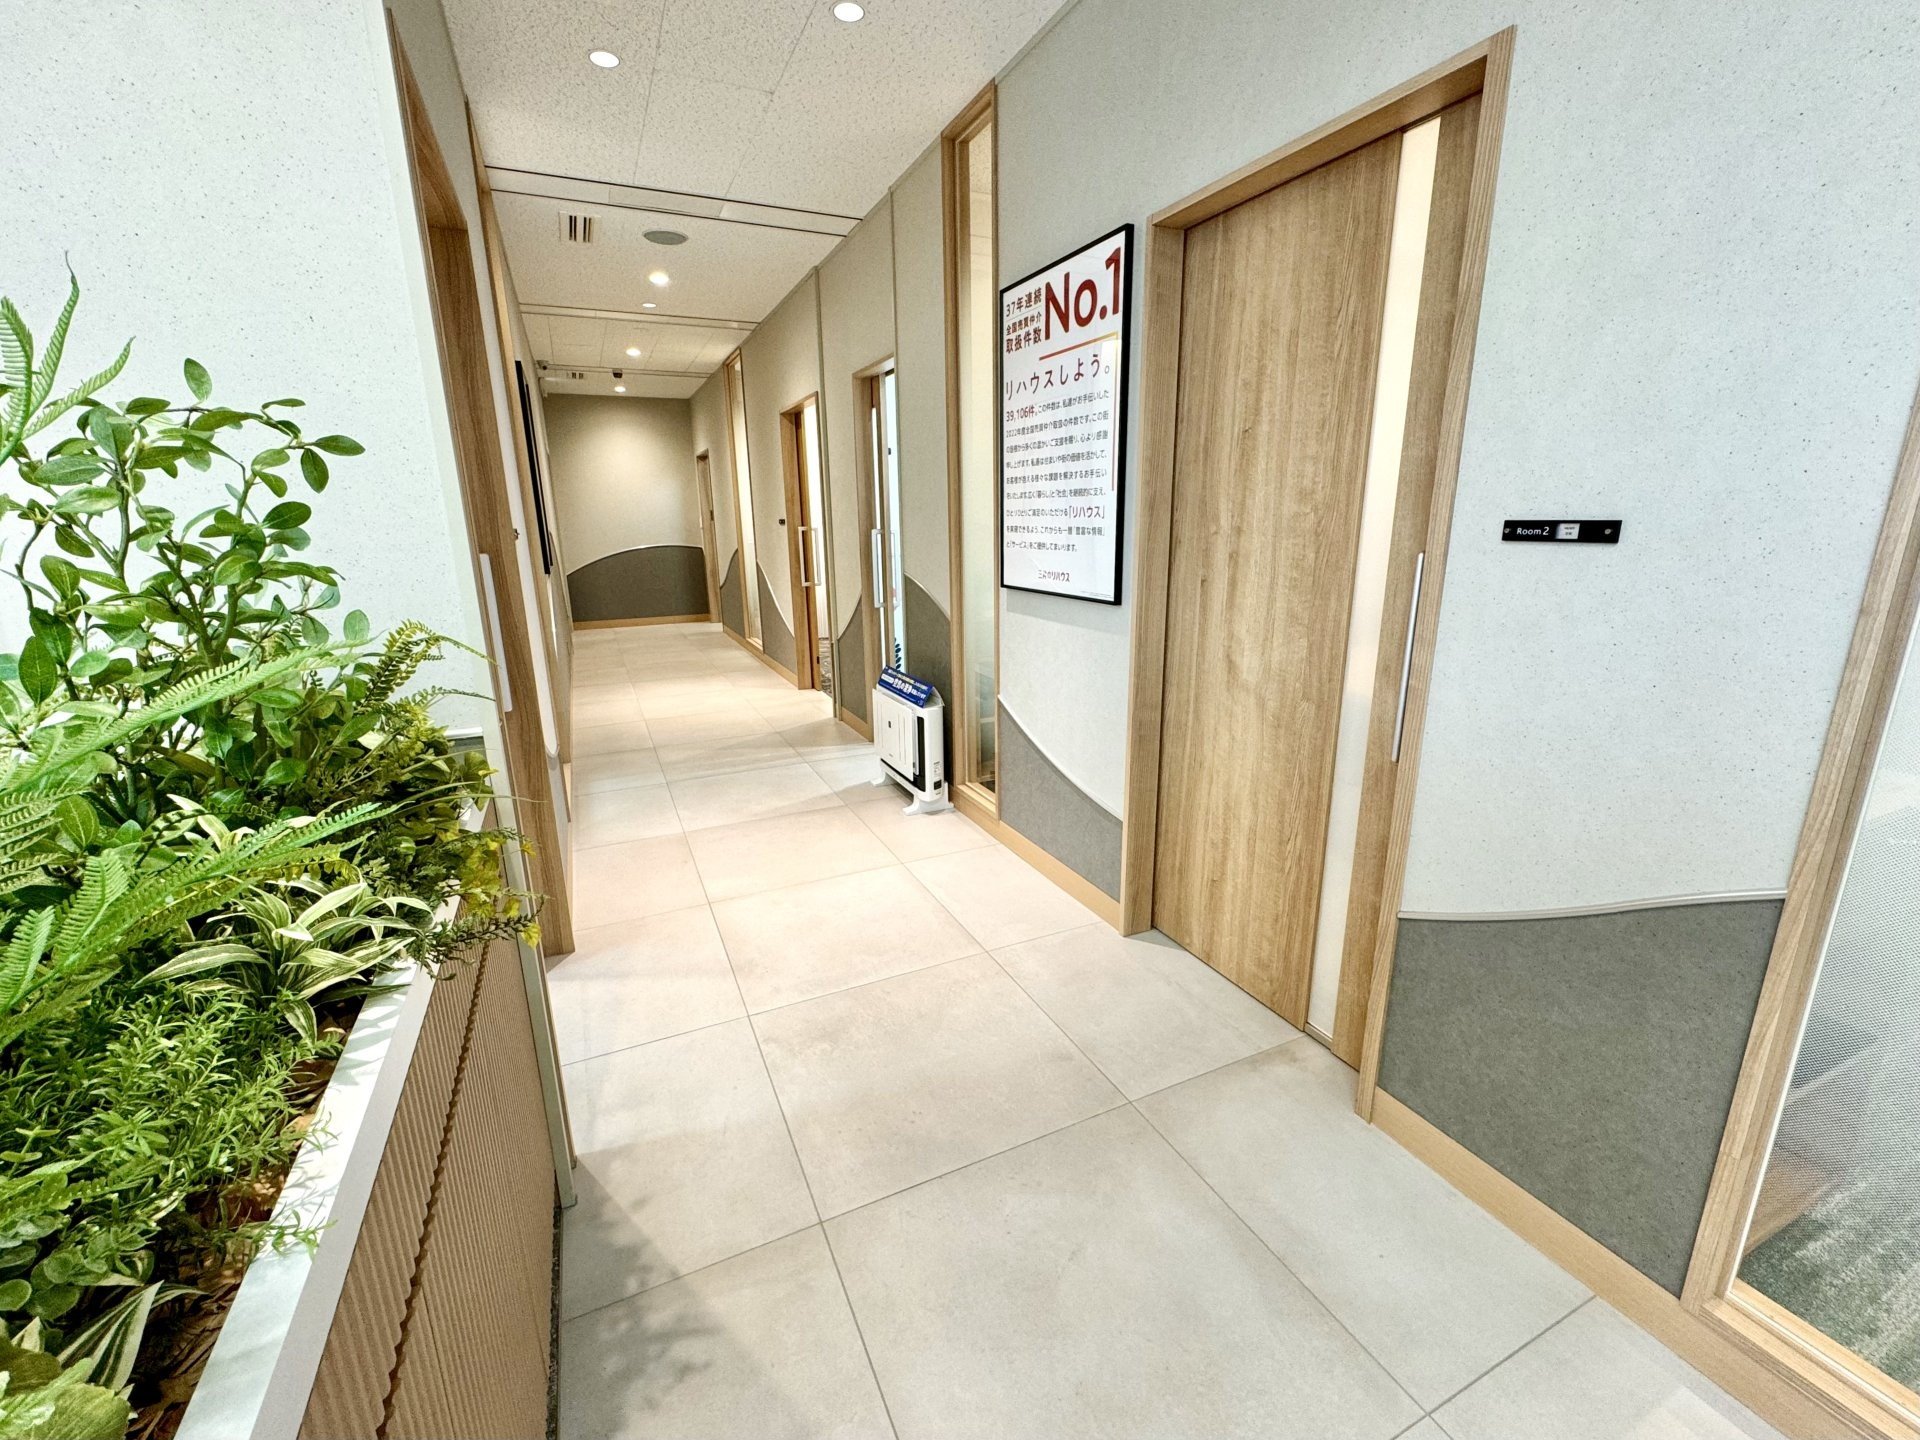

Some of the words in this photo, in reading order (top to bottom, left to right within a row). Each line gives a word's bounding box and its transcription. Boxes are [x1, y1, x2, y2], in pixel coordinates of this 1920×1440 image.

[1006, 287, 1042, 317] 37年連続
[1045, 247, 1121, 340] No.1
[1006, 326, 1042, 354] 取扱件数
[1006, 354, 1110, 400] リハウスしよう。
[1516, 527, 1542, 535] Room
[1543, 526, 1550, 536] 2
